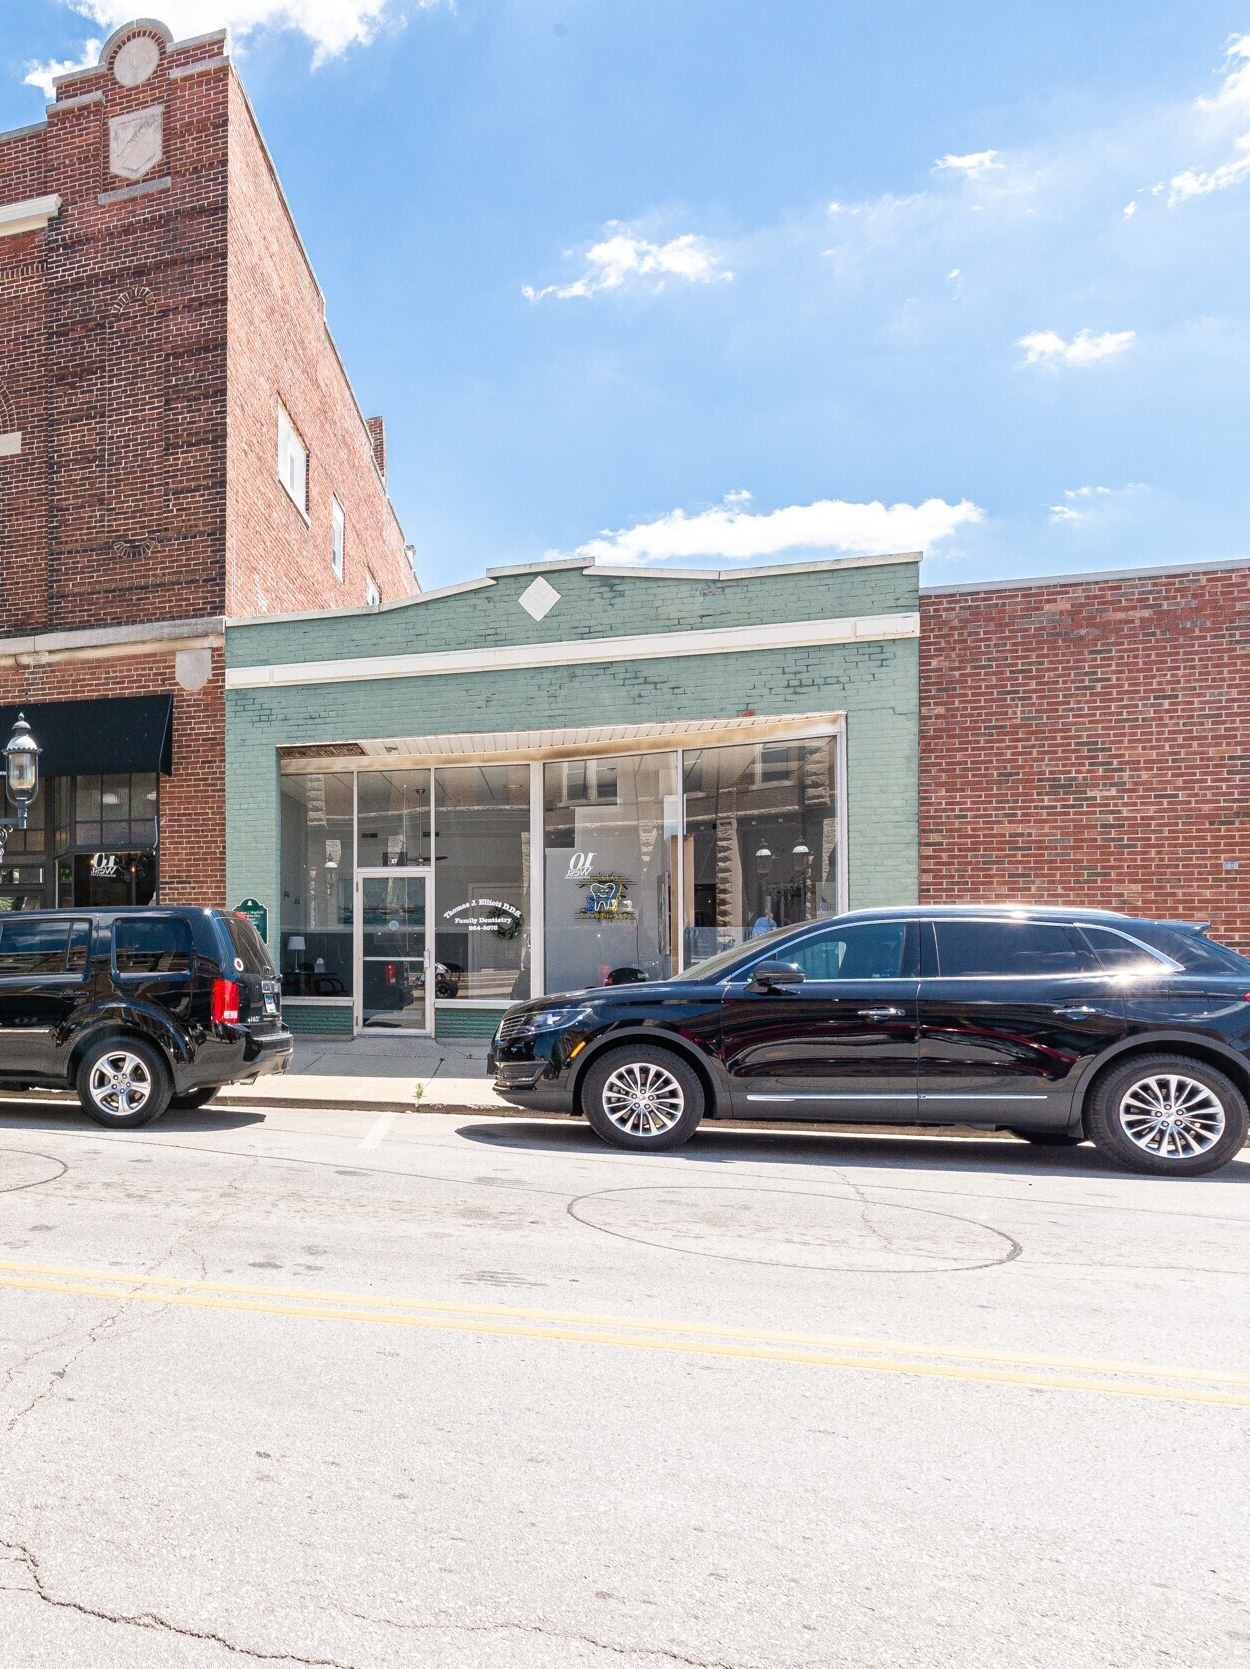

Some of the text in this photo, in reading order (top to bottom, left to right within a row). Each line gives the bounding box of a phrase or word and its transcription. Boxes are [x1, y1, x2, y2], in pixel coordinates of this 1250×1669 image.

[443, 902, 470, 919] Thomas
[478, 899, 502, 908] Elliott
[502, 902, 522, 918] D.D.S.
